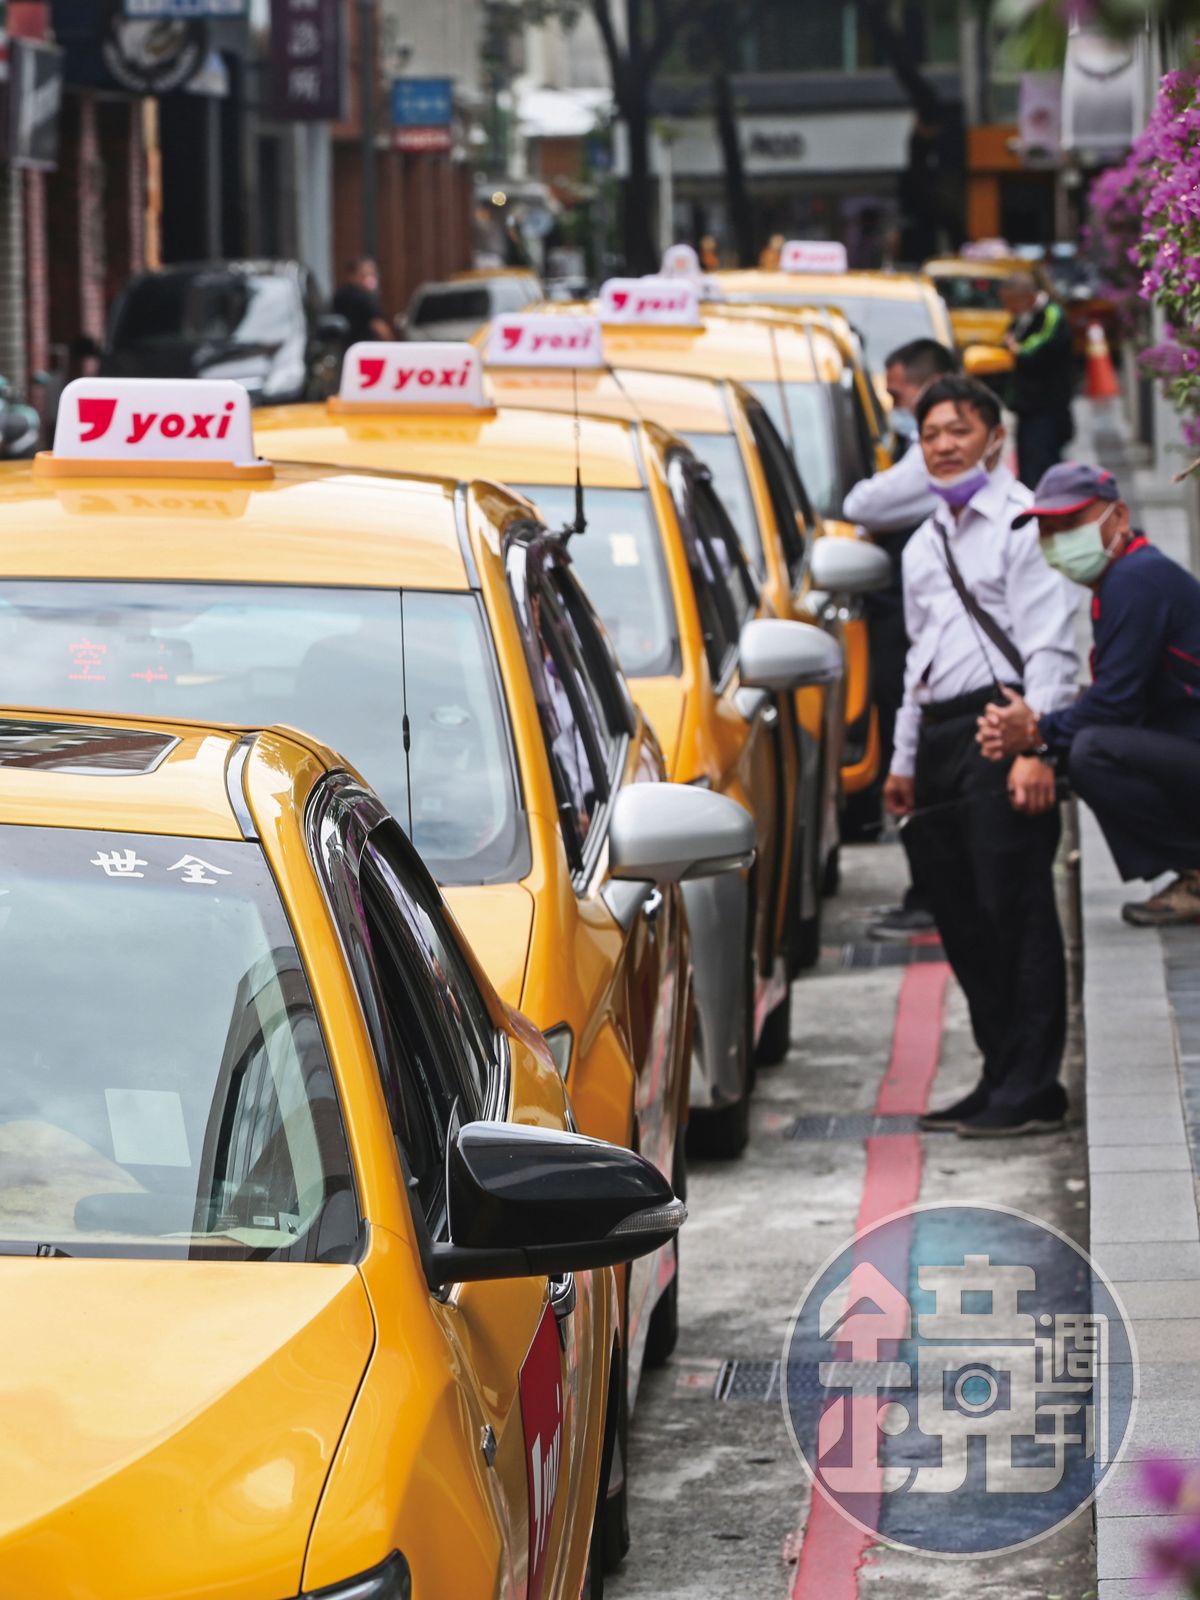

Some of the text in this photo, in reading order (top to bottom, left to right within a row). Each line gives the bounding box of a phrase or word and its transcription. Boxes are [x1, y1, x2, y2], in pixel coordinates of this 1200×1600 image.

[288, 0, 320, 103] 診所
[634, 293, 689, 314] yoxi
[530, 328, 594, 352] yoxi
[393, 360, 473, 391] yoxi
[125, 401, 236, 444] yoxi
[90, 848, 233, 885] 世全
